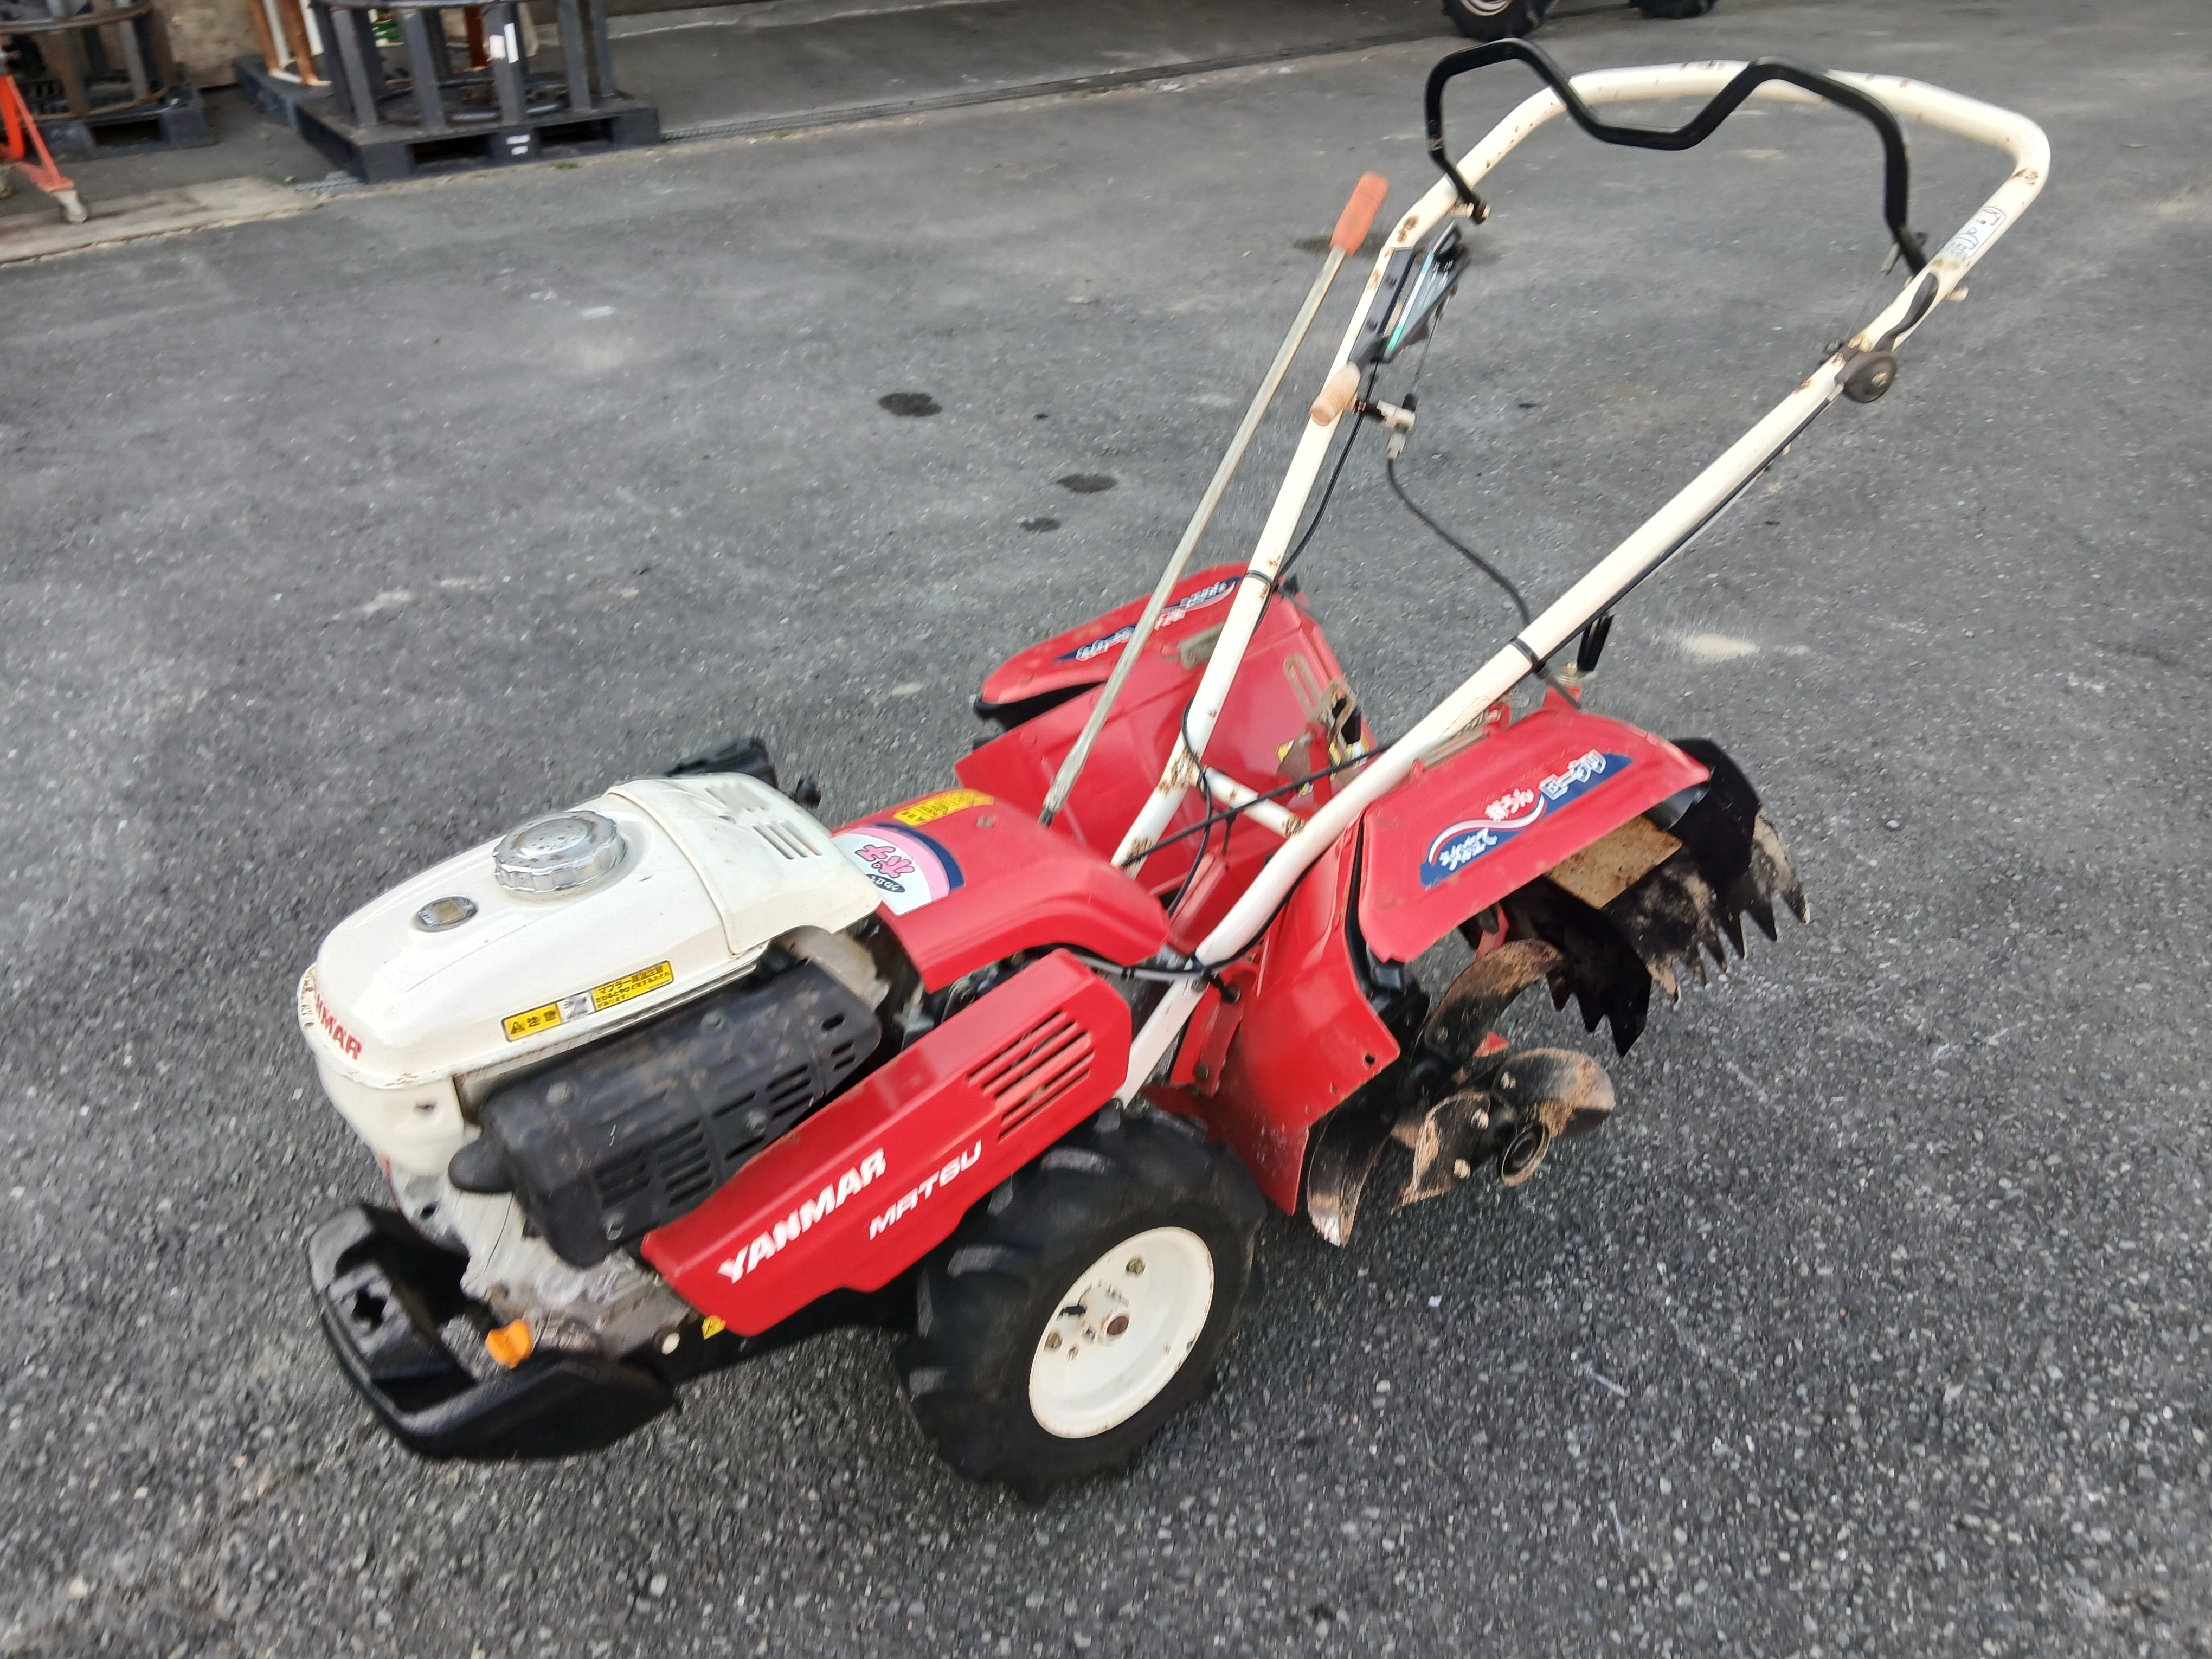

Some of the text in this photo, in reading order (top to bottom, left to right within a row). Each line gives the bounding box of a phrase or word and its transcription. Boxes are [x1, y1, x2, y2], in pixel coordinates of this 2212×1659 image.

[1539, 749, 1606, 800] ロータリ
[854, 844, 915, 879] ポチ
[718, 1147, 886, 1284] YANMAR
